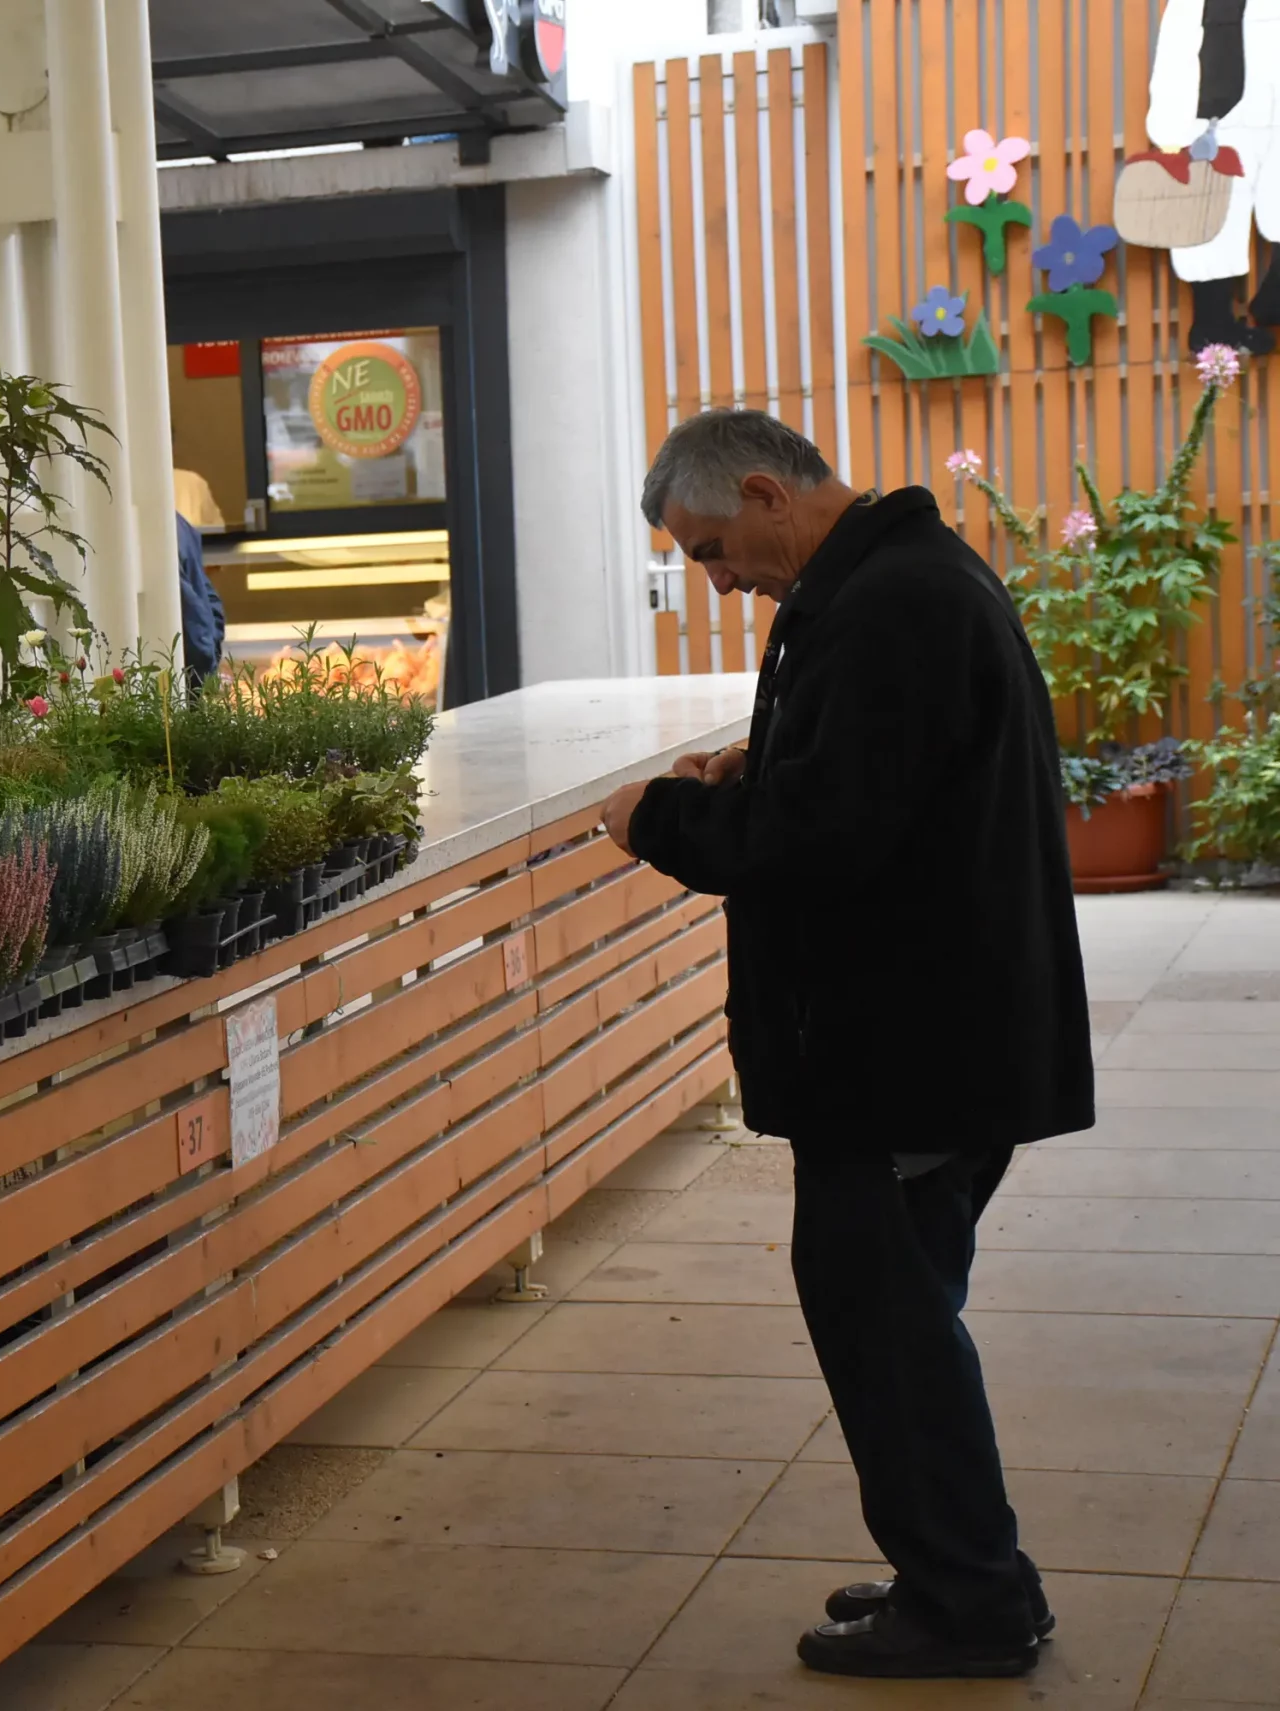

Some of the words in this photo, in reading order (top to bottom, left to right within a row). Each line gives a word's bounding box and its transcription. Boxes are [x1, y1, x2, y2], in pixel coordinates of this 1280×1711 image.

[333, 359, 370, 394] NE
[336, 404, 392, 432] GMO
[188, 1114, 203, 1156] 37
